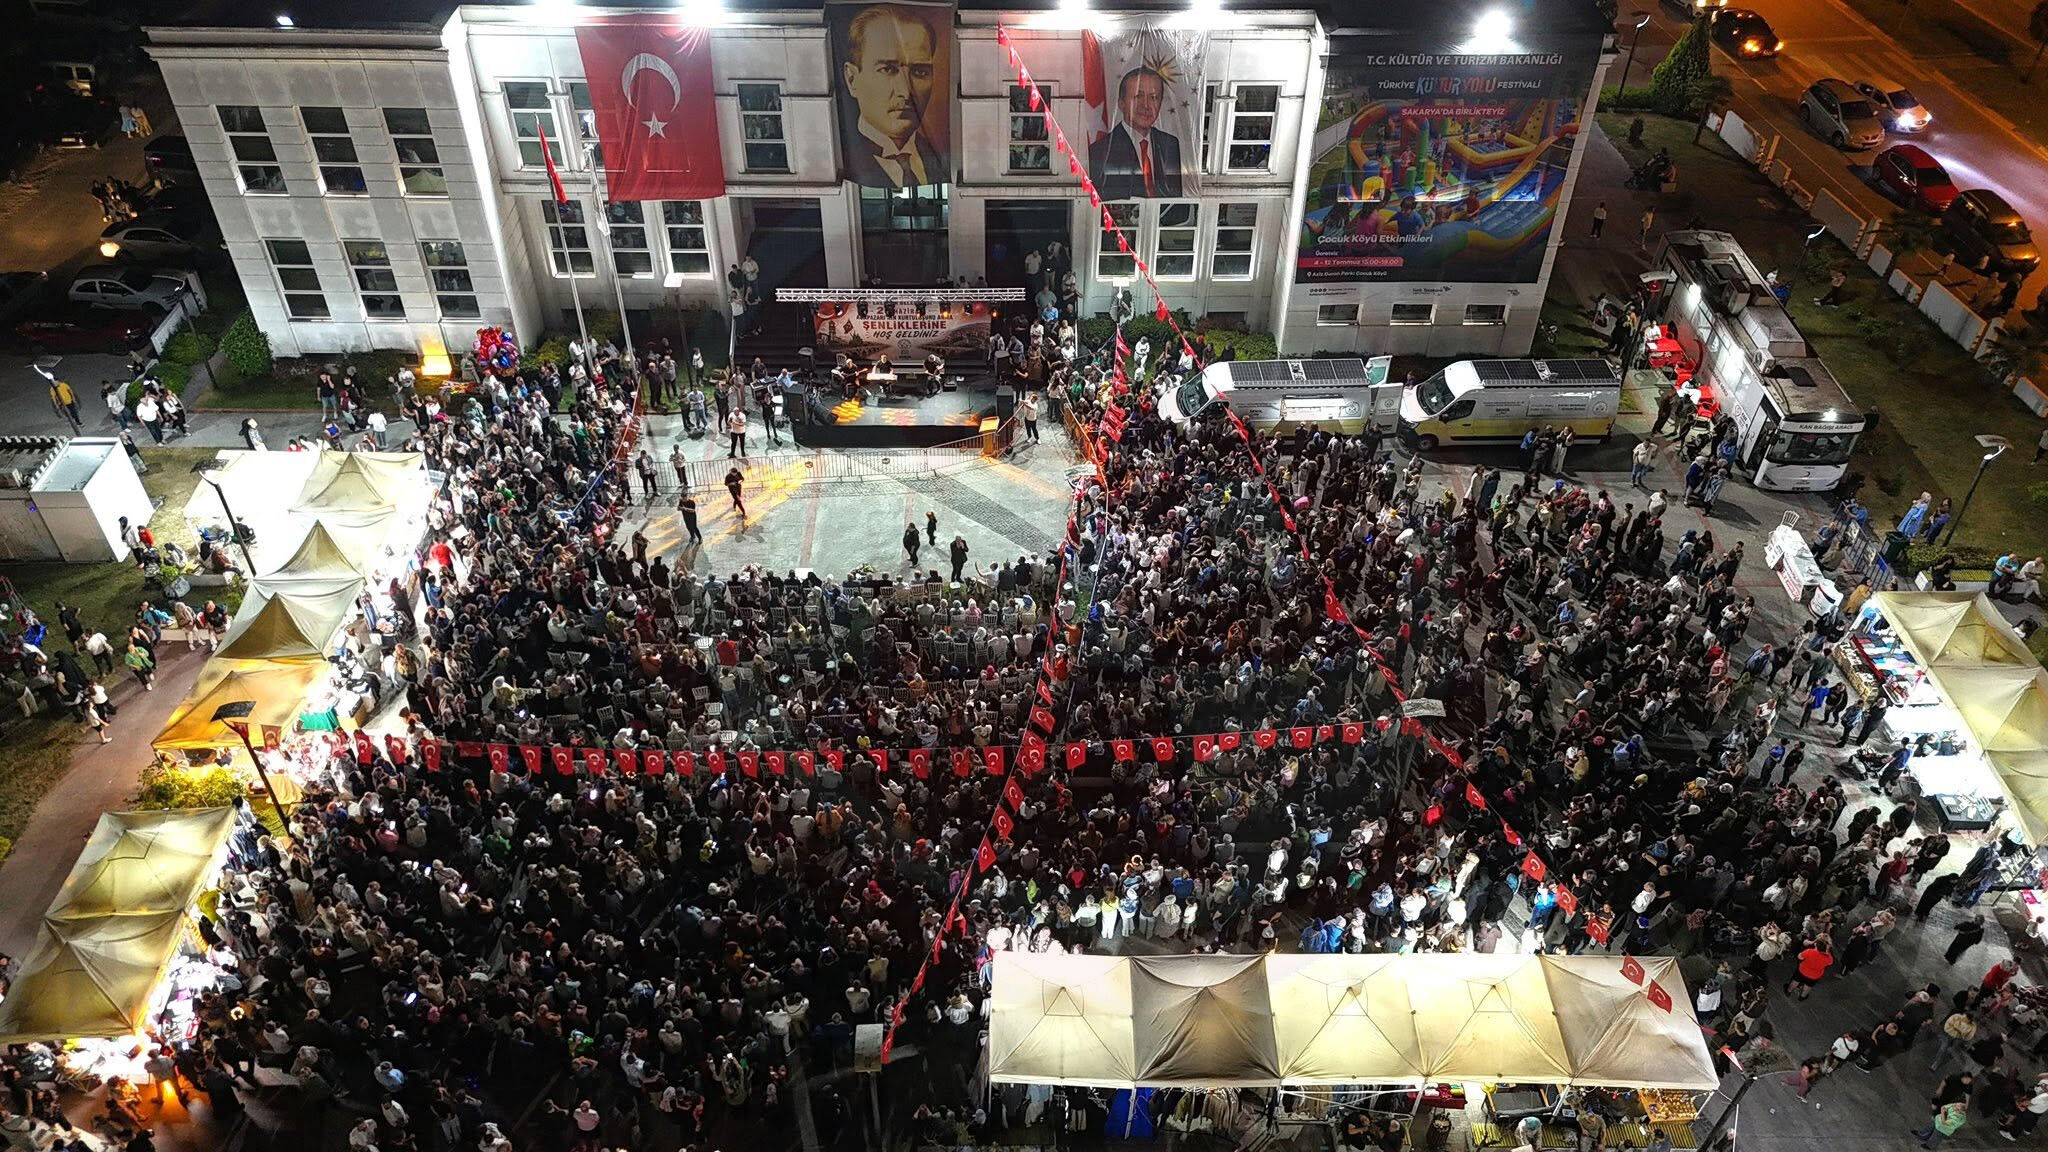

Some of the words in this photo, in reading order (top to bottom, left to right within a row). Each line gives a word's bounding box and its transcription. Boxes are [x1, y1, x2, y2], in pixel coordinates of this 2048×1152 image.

[1367, 55, 1386, 65] T.C.
[1389, 53, 1432, 65] KÜLTÜR
[1437, 55, 1450, 65] VE
[1500, 53, 1563, 65] BAKANLIĞI
[1378, 79, 1415, 89] TÜRKİYE
[1497, 79, 1541, 89] FESTİVALİ
[1402, 107, 1454, 116] SAKARYA'DA
[1455, 106, 1506, 116] BİRLİKTEYİZ
[1318, 235, 1350, 245] Çocuk
[1352, 234, 1377, 245] Köyü
[1379, 234, 1433, 243] Etkinlikleri
[863, 320, 947, 330] ŞENLİKLERİNE
[873, 330, 892, 339] HOŞ
[896, 330, 939, 338] GELDİNİZ
